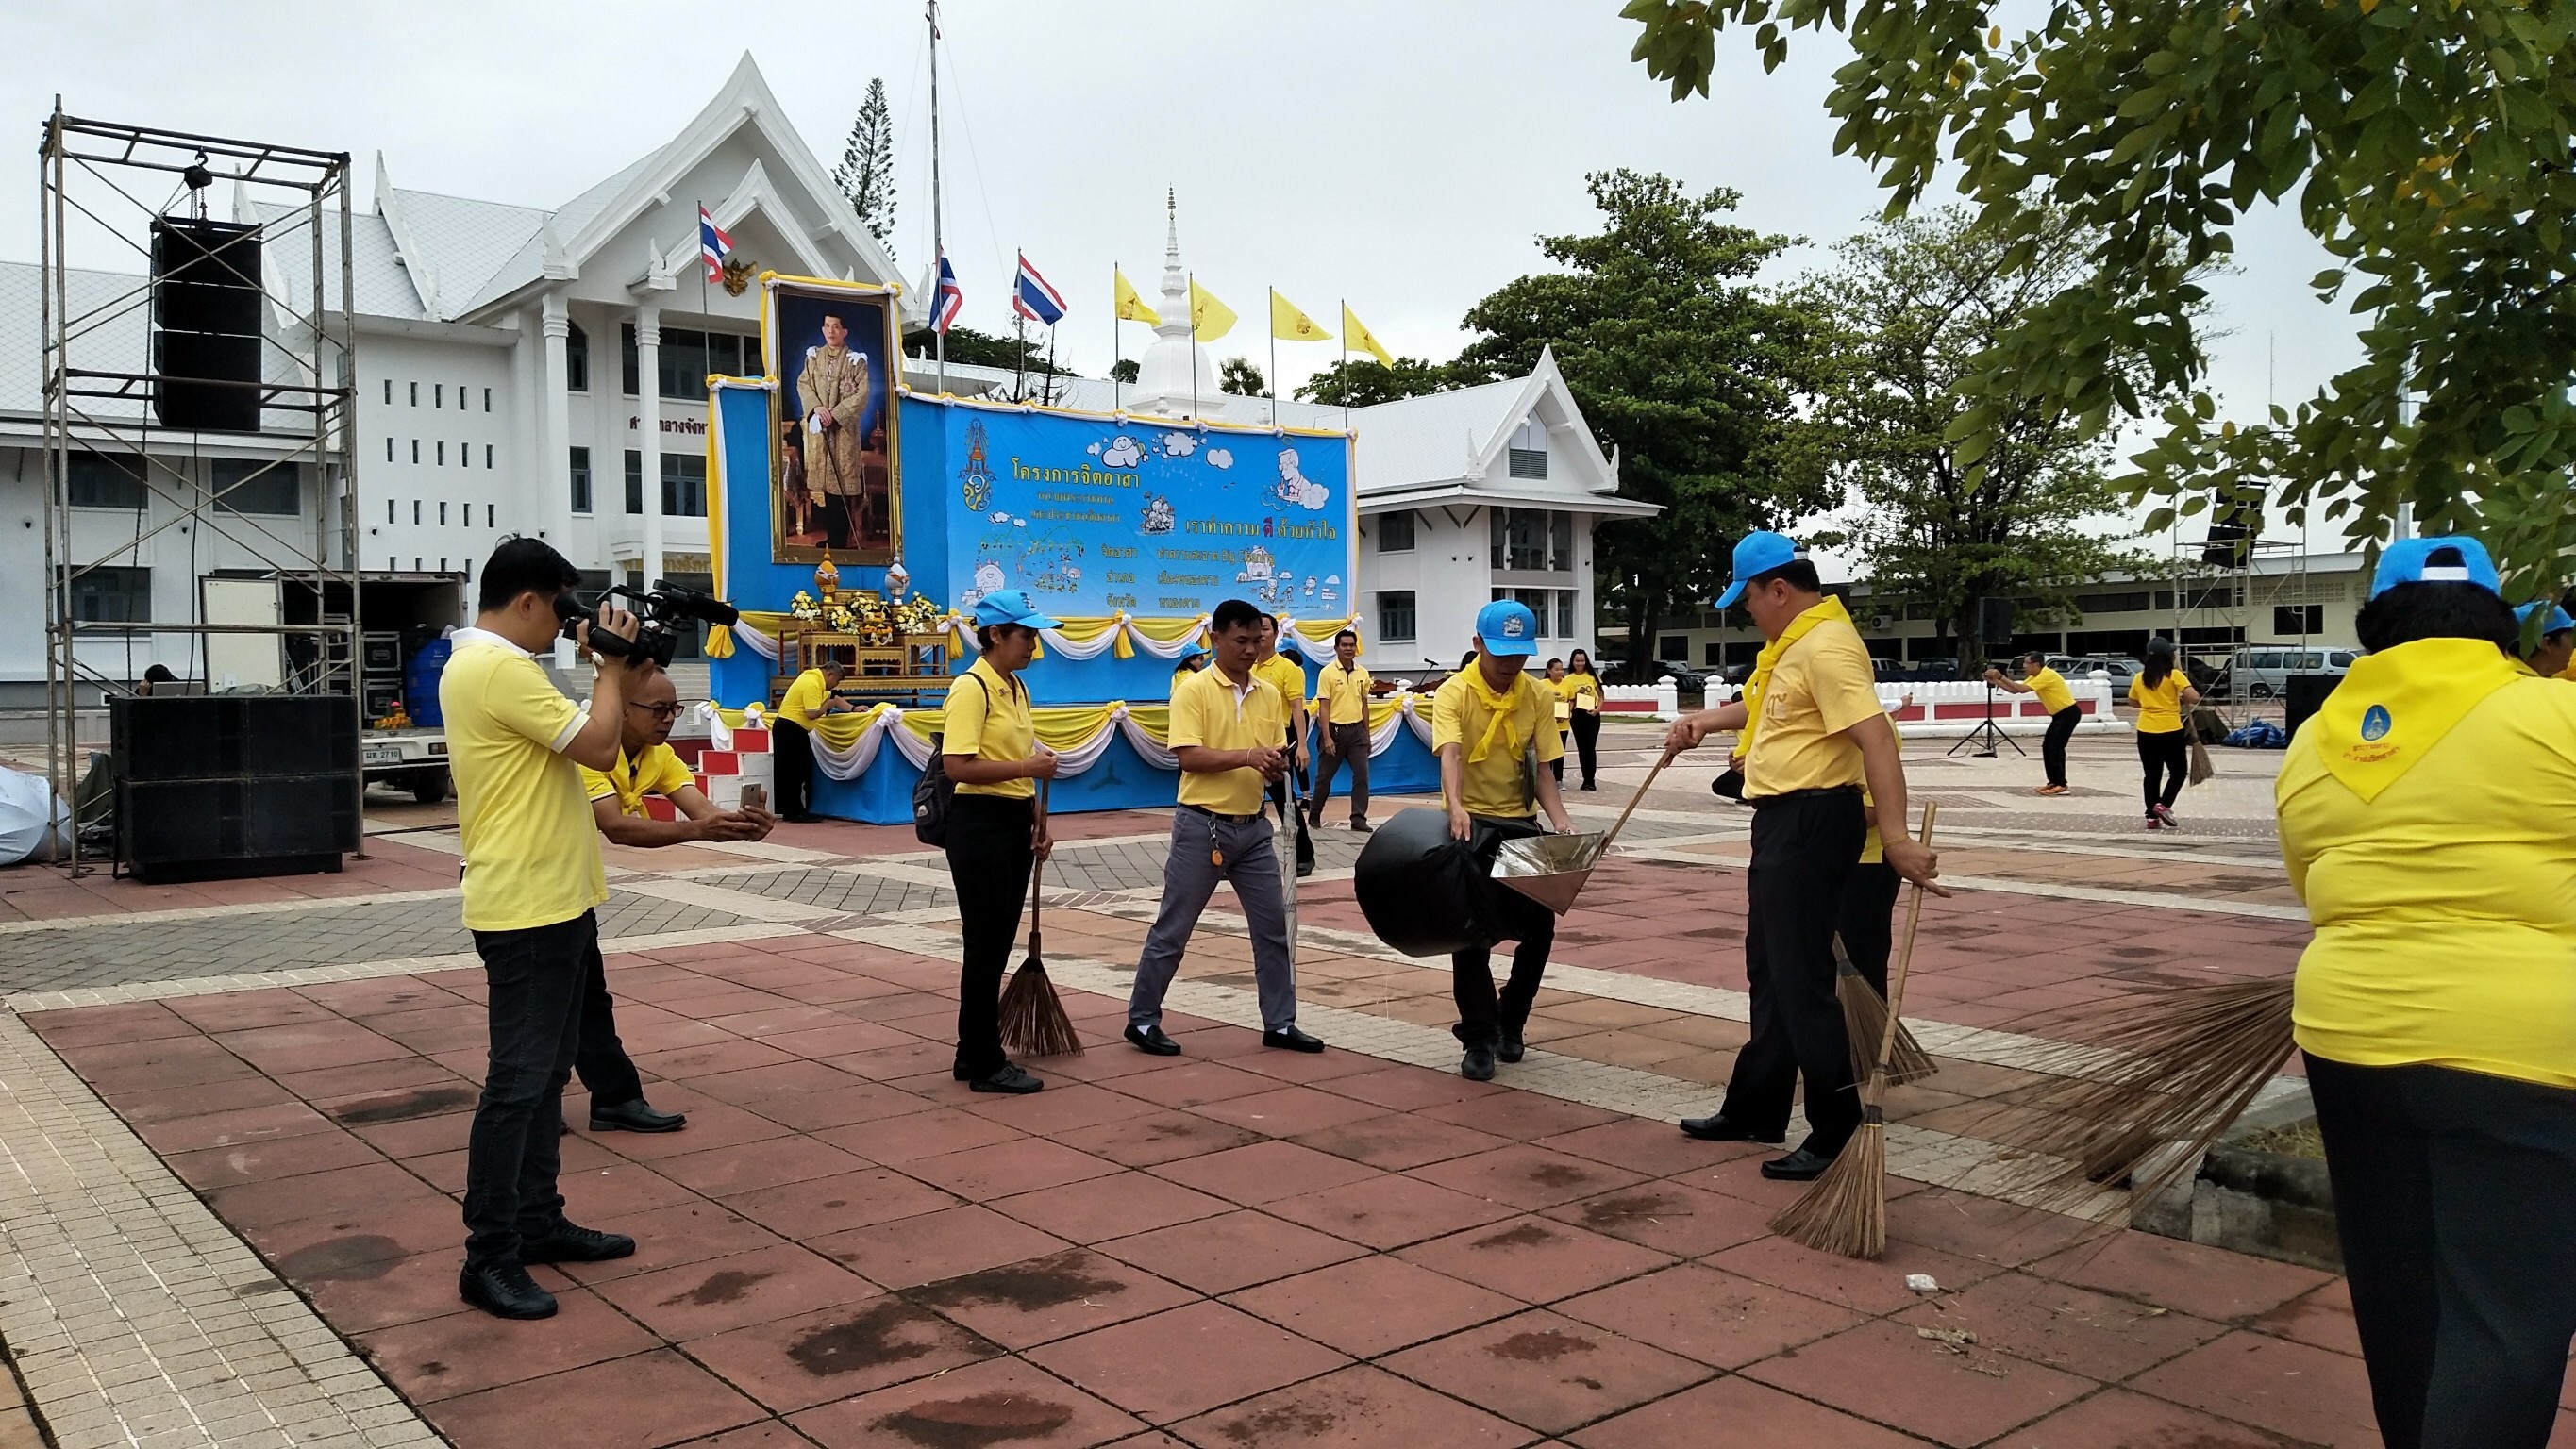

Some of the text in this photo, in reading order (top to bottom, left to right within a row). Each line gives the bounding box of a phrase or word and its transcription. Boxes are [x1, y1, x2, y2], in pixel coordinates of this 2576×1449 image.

[1011, 457, 1140, 489] โครงการจิตอาสา
[1185, 515, 1337, 541] เราทำความ ดี ด้วยหัวใจ
[1101, 543, 1138, 558] จิตอาสา
[1157, 546, 1219, 562] ทำความสะอาด
[1222, 549, 1235, 565] Big
[1106, 570, 1135, 583] อำเภอ
[1106, 592, 1201, 608] จังหวัด หนองคาย
